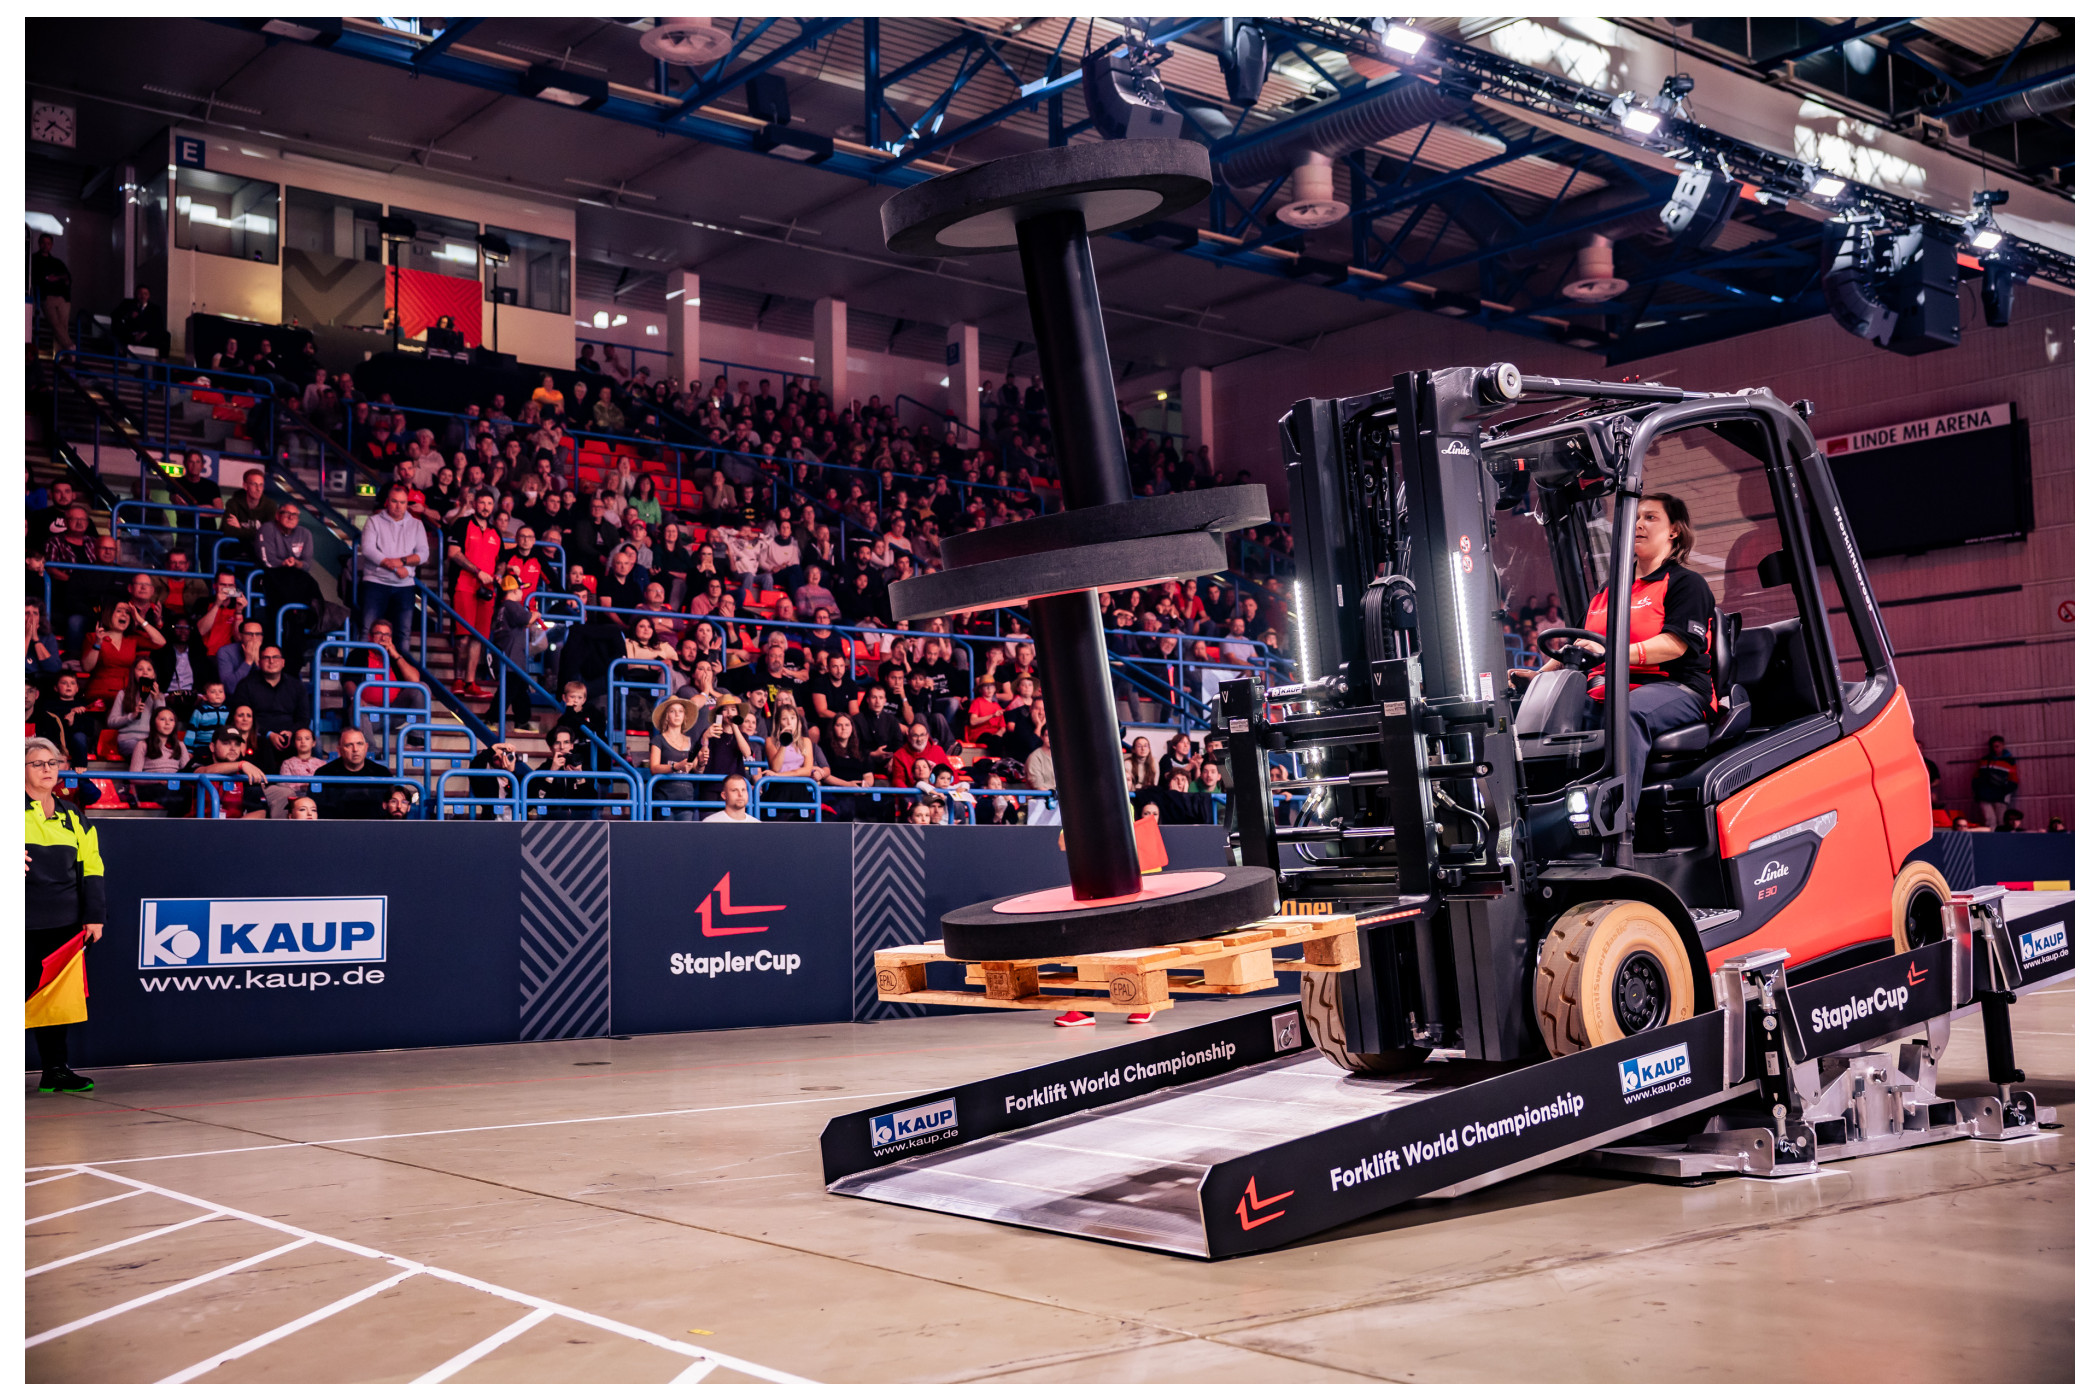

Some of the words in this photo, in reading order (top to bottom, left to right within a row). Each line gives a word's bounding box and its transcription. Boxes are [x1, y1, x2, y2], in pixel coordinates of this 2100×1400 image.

[183, 141, 198, 163] E
[1853, 428, 1897, 450] LINDE
[1903, 422, 1929, 441] MH
[1935, 410, 1992, 435] ARENA
[1441, 440, 1470, 455] Linde
[1753, 860, 1789, 885] Linde
[220, 921, 375, 955] KAUP
[2034, 931, 2064, 952] KAUP
[670, 949, 801, 978] StaplerCup
[2023, 948, 2069, 970] www.kaup.de
[139, 966, 386, 992] www.kaup.de
[879, 974, 895, 986] EPAL
[1113, 983, 1132, 996] EPAL
[1811, 986, 1908, 1033] StaplerCup
[1005, 1083, 1067, 1114] Forklift
[1070, 1068, 1120, 1097] World
[1123, 1040, 1236, 1083] Championship
[1641, 1055, 1686, 1082] KAUP
[1623, 1076, 1692, 1105] www.kaup.de
[897, 1109, 953, 1136] KAUP
[873, 1129, 959, 1157] www.kaup.de
[1330, 1150, 1401, 1192] Forklift
[1402, 1129, 1459, 1167] World
[1461, 1092, 1585, 1147] Championship
